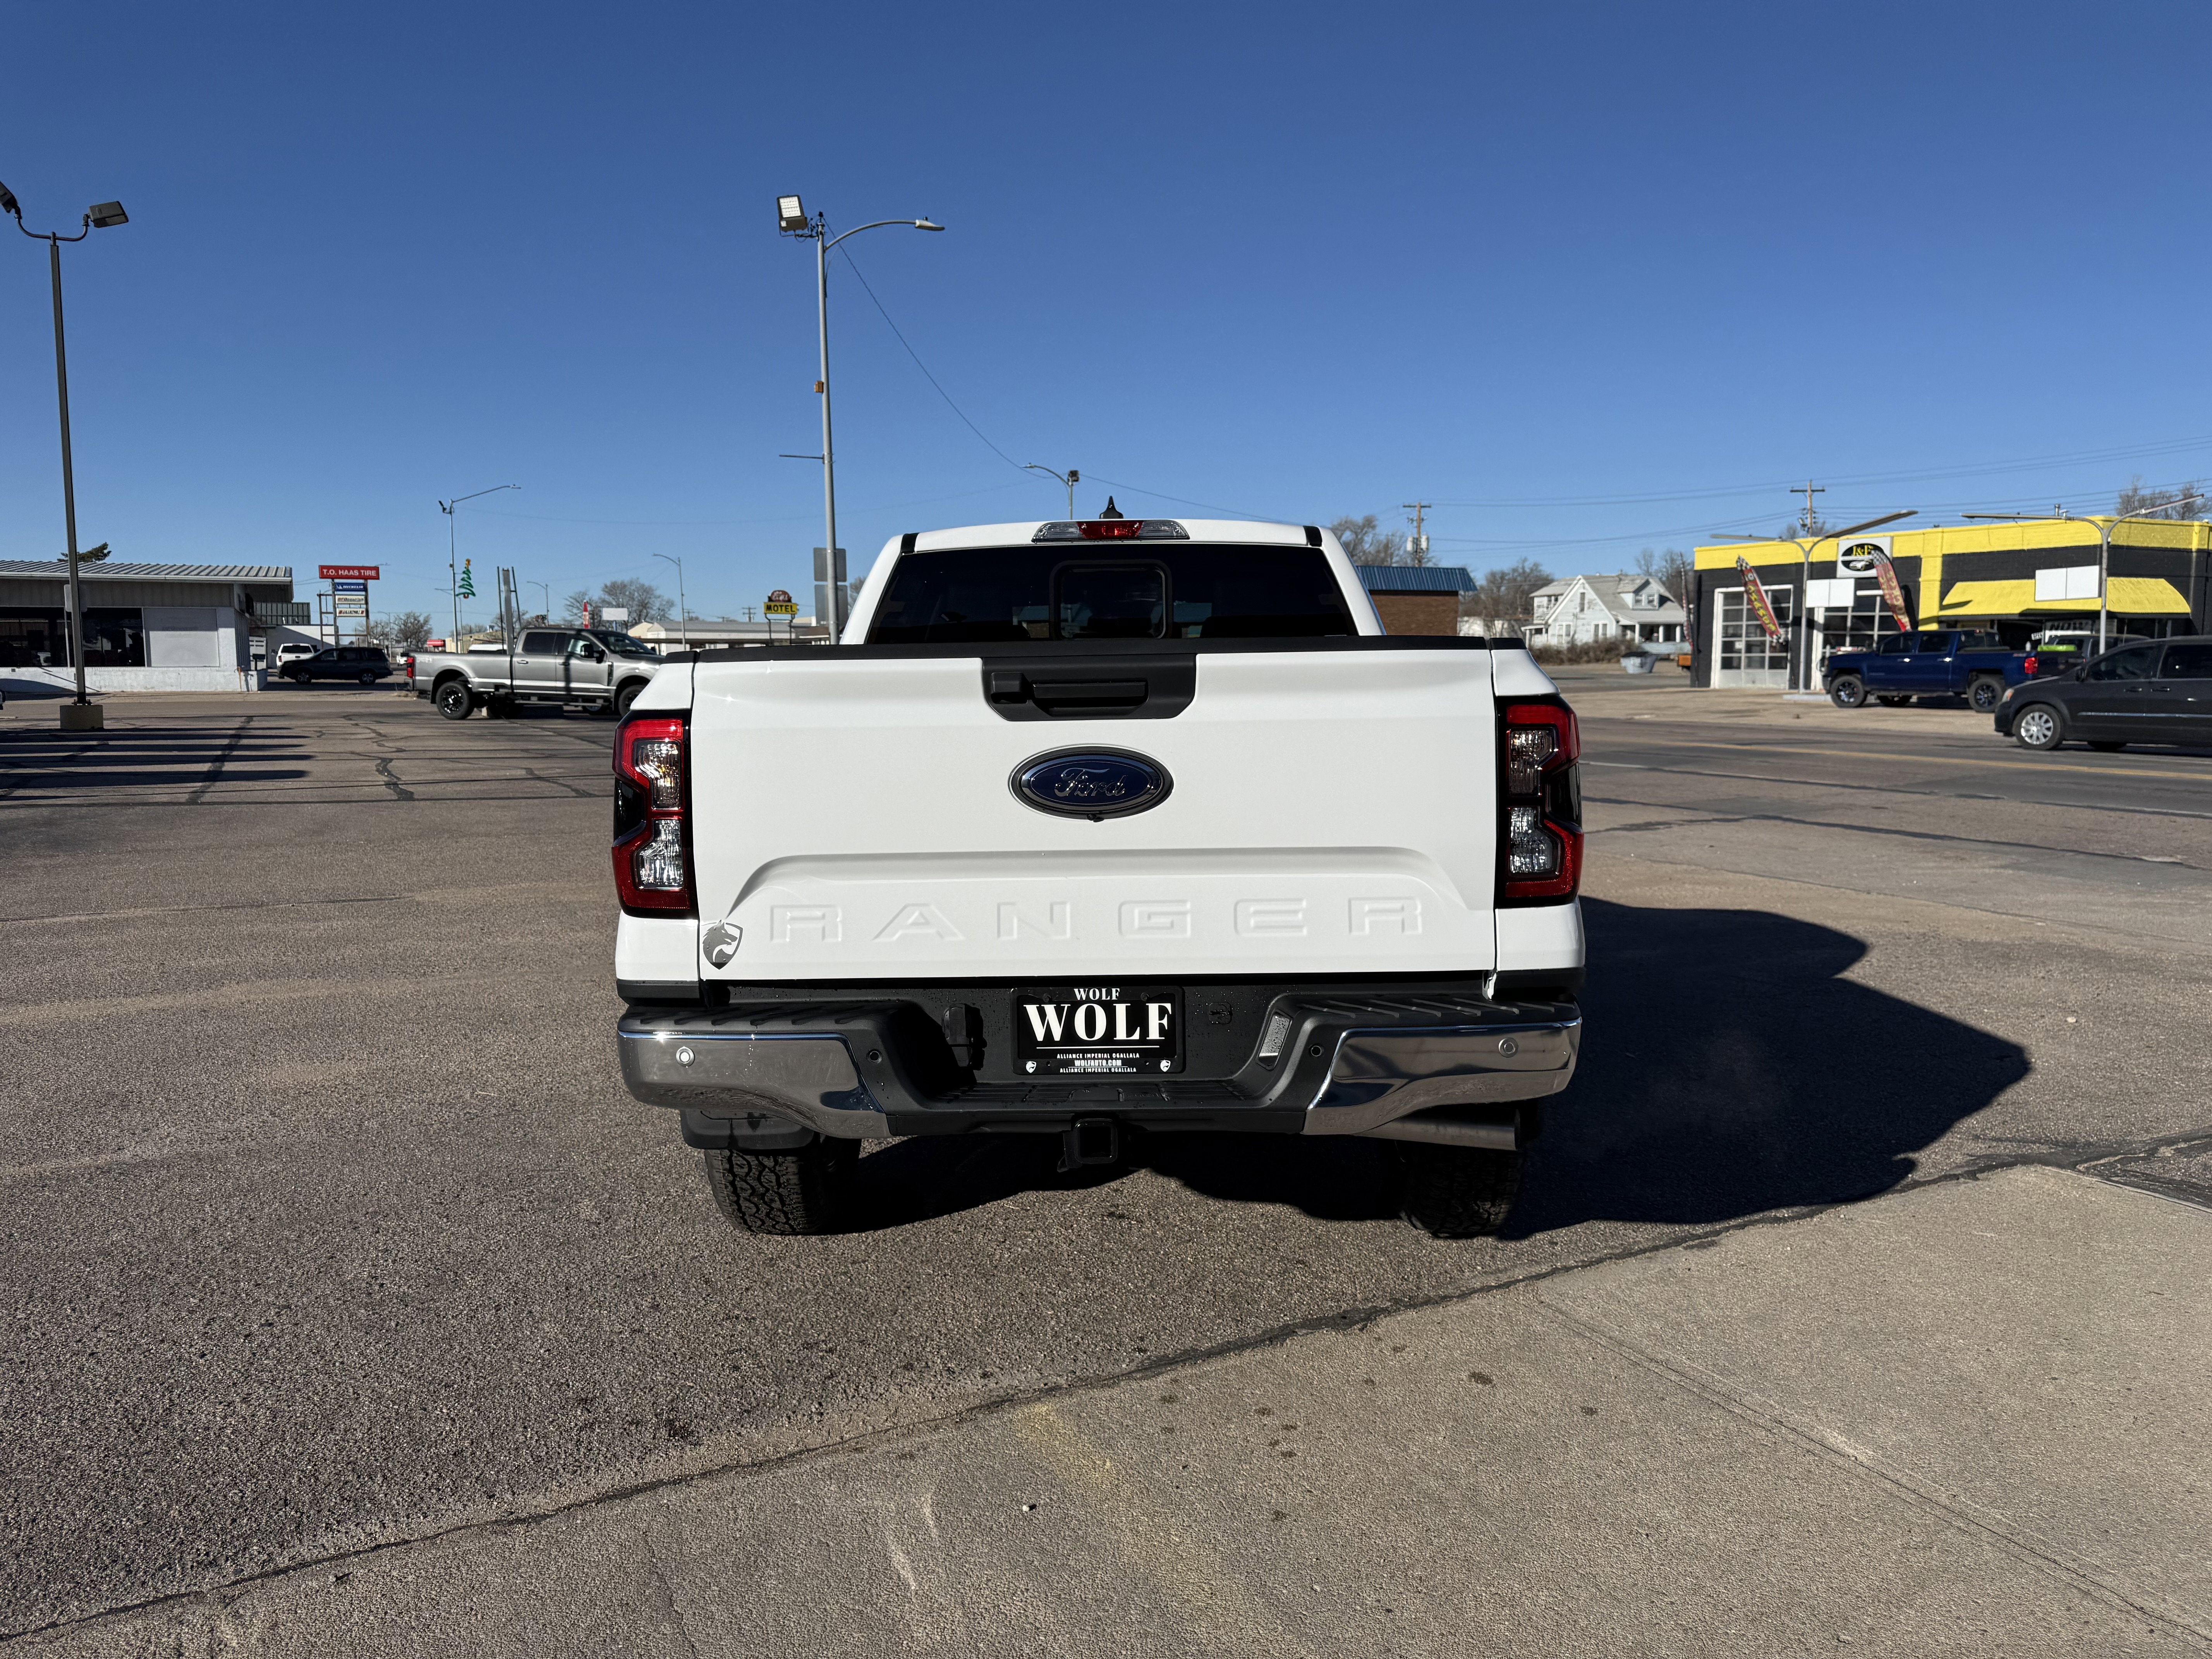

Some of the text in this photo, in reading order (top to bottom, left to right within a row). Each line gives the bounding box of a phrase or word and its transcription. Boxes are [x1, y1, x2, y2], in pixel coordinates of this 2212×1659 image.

[766, 604, 795, 612] MOTEL
[1054, 768, 1128, 797] Ford
[769, 896, 1422, 943] RANGER
[1074, 988, 1120, 1000] WOLF
[1023, 1003, 1172, 1041] WOLF
